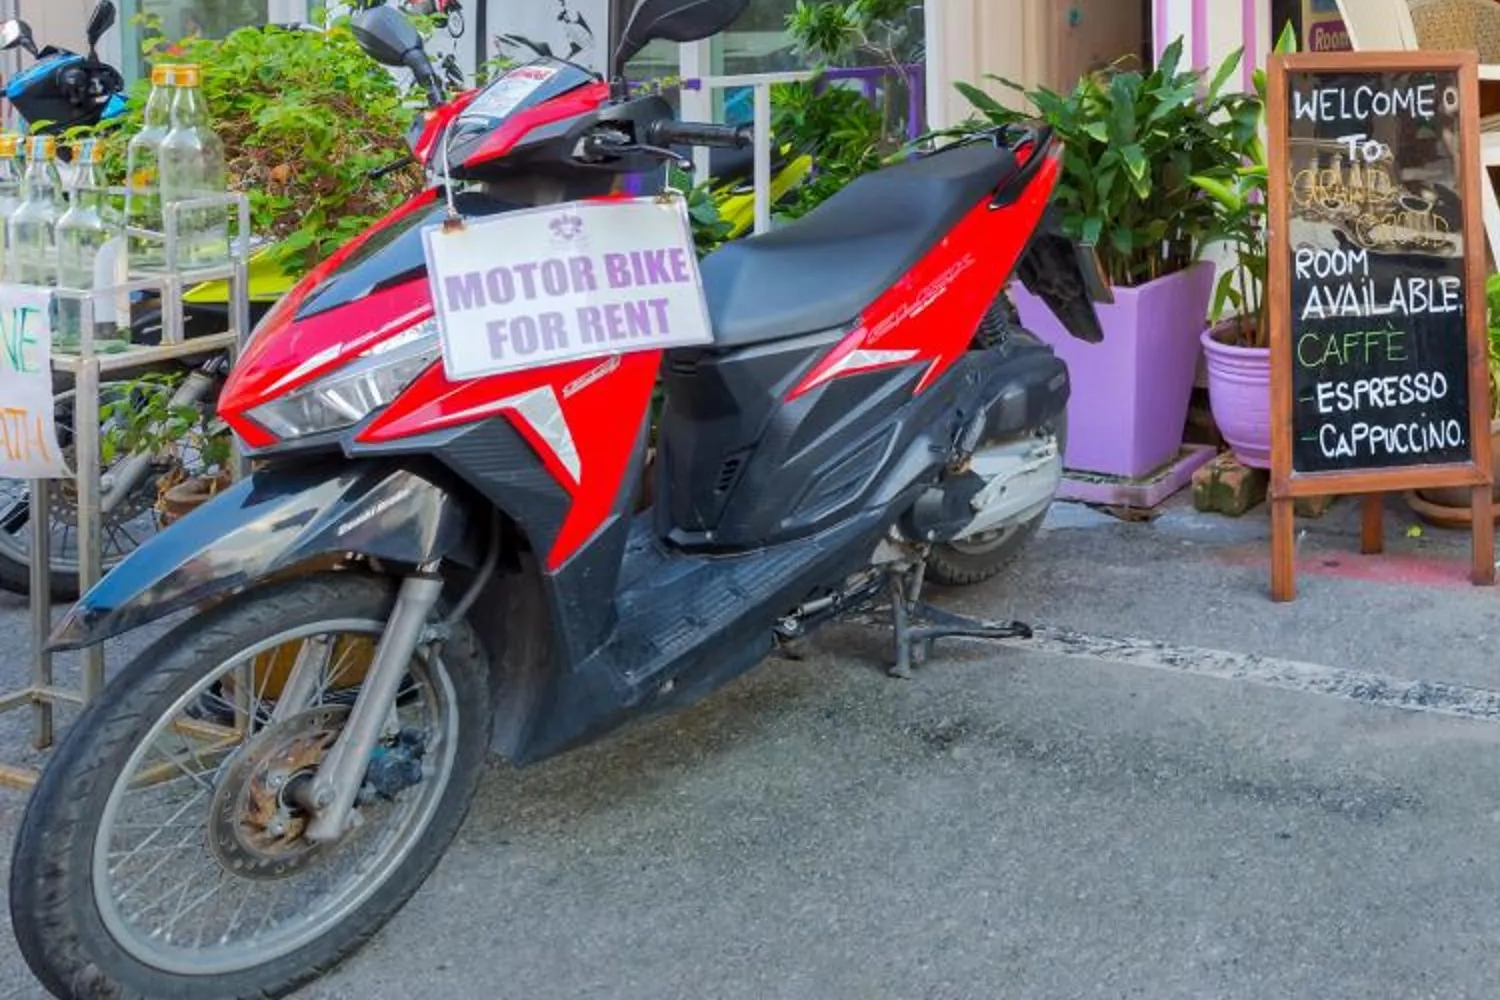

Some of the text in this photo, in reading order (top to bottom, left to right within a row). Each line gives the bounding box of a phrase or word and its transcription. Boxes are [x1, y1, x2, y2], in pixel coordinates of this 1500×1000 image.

[1293, 84, 1436, 122] WELCOME
[444, 247, 691, 312] MOTOR BIKE
[1295, 248, 1370, 280] ROOM
[486, 298, 670, 361] FOR RENT
[1316, 371, 1449, 414] ESPRESSO
